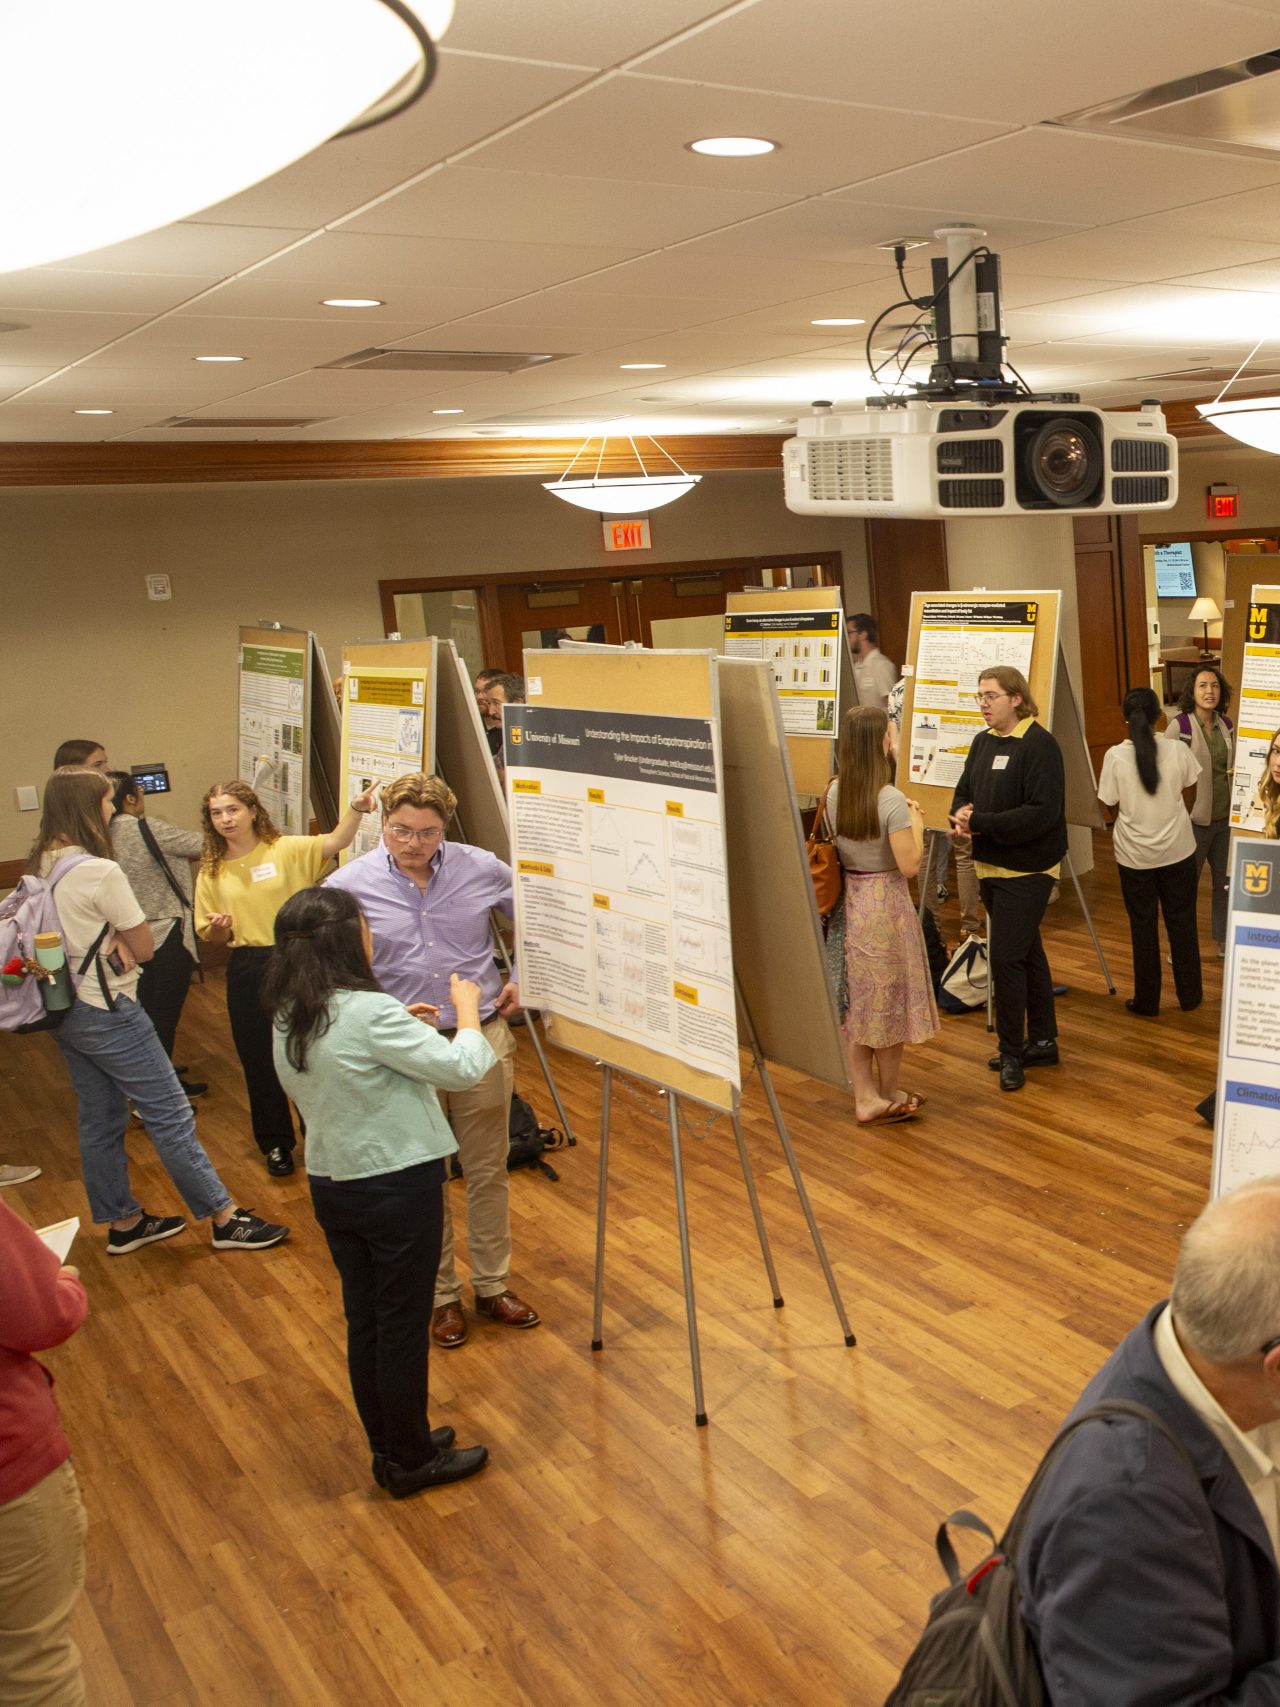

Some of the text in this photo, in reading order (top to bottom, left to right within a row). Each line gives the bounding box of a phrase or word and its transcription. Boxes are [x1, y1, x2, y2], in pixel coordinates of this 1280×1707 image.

[1216, 498, 1234, 516] EXIT
[611, 522, 643, 548] EXIT
[525, 731, 551, 746] University
[557, 734, 580, 746] Missouri
[585, 728, 621, 743] Understanding
[621, 731, 630, 741] the
[630, 732, 651, 745] Impacts
